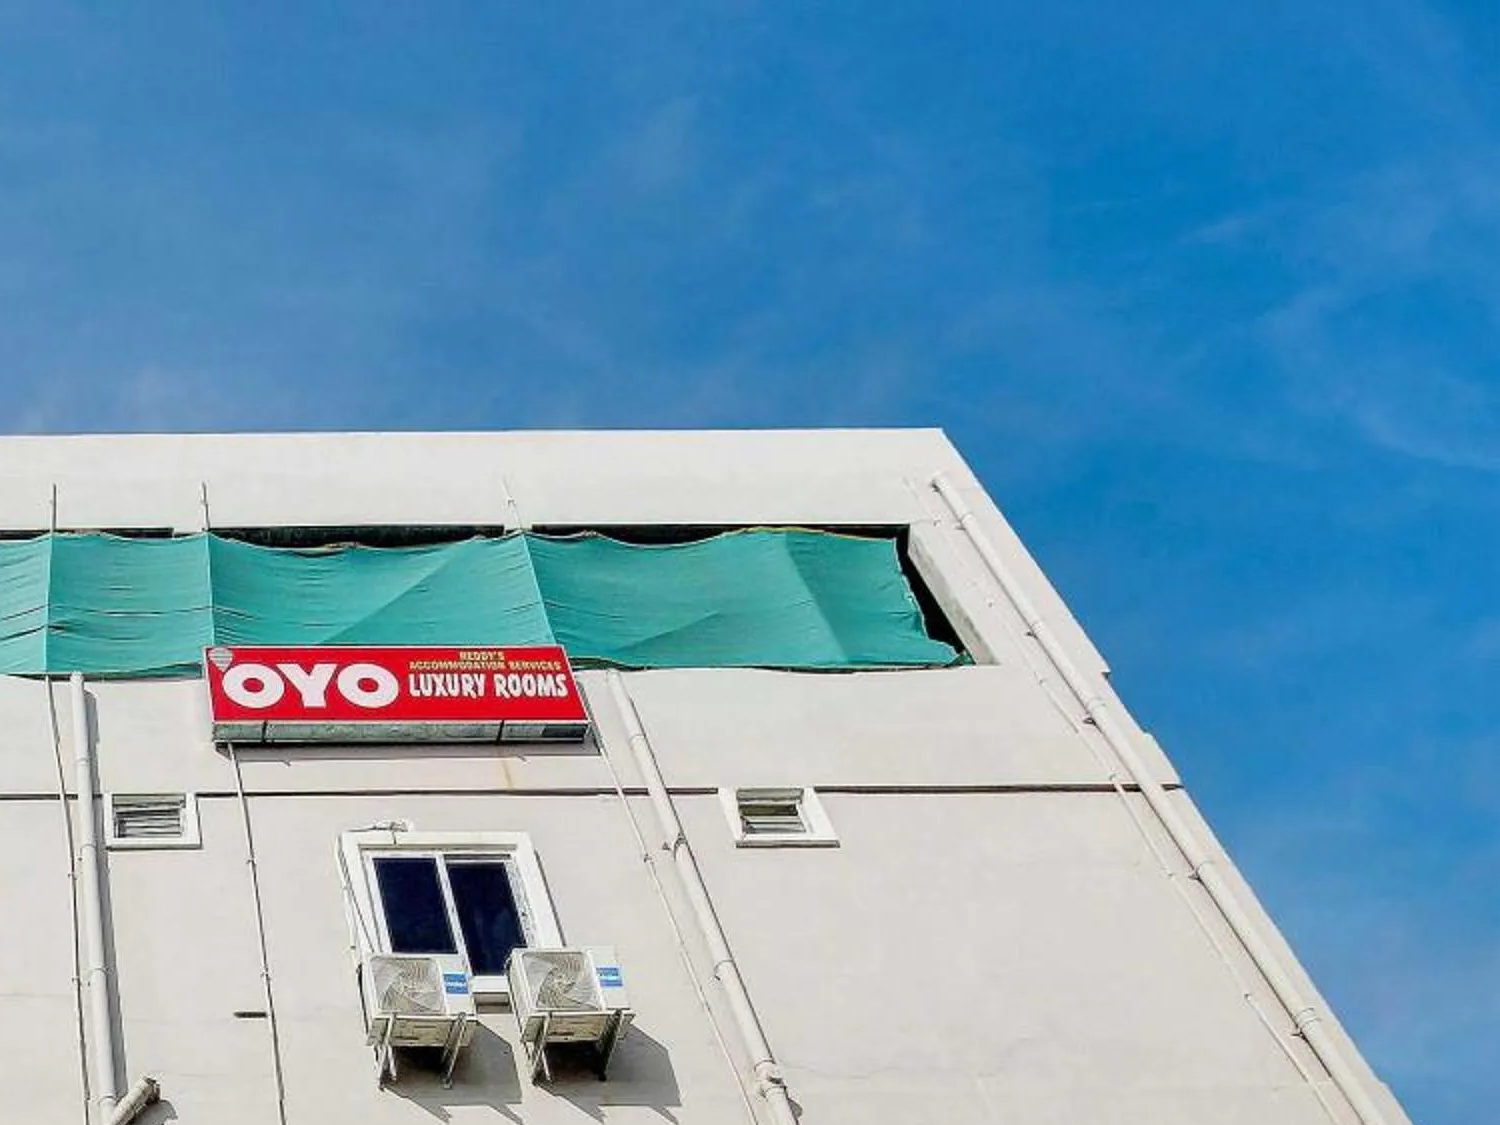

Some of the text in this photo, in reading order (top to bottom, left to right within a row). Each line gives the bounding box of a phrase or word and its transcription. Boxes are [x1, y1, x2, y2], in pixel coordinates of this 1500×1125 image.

[222, 663, 399, 708] OYO
[409, 673, 568, 698] LUXURY ROOMS
